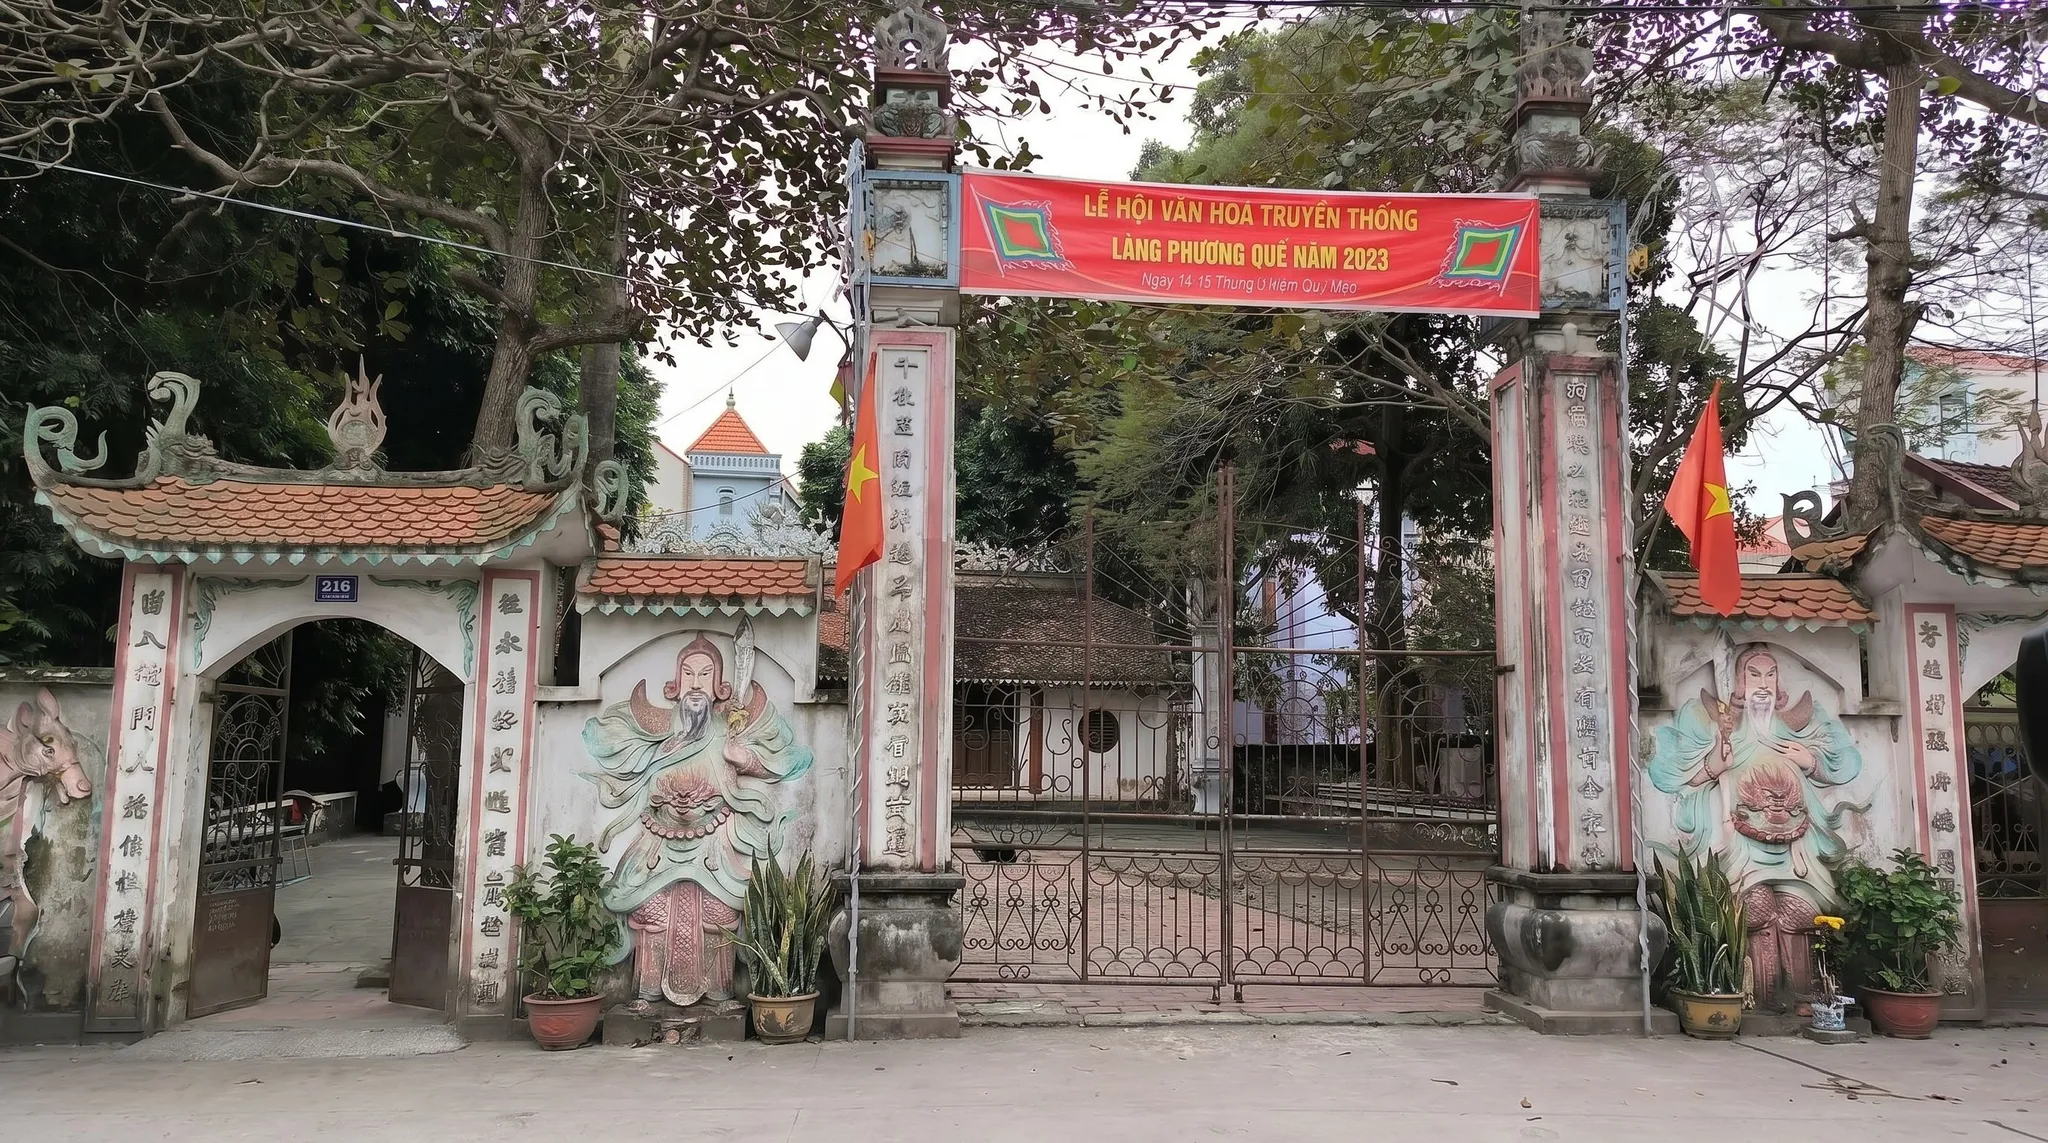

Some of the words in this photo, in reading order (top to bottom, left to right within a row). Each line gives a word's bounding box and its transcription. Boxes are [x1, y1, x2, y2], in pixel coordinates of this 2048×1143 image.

[1084, 188, 1109, 218] LỄ
[1116, 193, 1153, 225] HỘI
[1161, 195, 1203, 223] VĂN
[1260, 200, 1340, 229] TRUYỀN
[1347, 201, 1418, 232] THỐNG
[1112, 232, 1162, 263] LÀNG
[1167, 238, 1245, 266] PHƯƠNG
[1251, 237, 1289, 270] QUẾ
[1293, 241, 1337, 270] NĂM
[1343, 247, 1389, 271] 2023
[321, 580, 351, 592] 216
